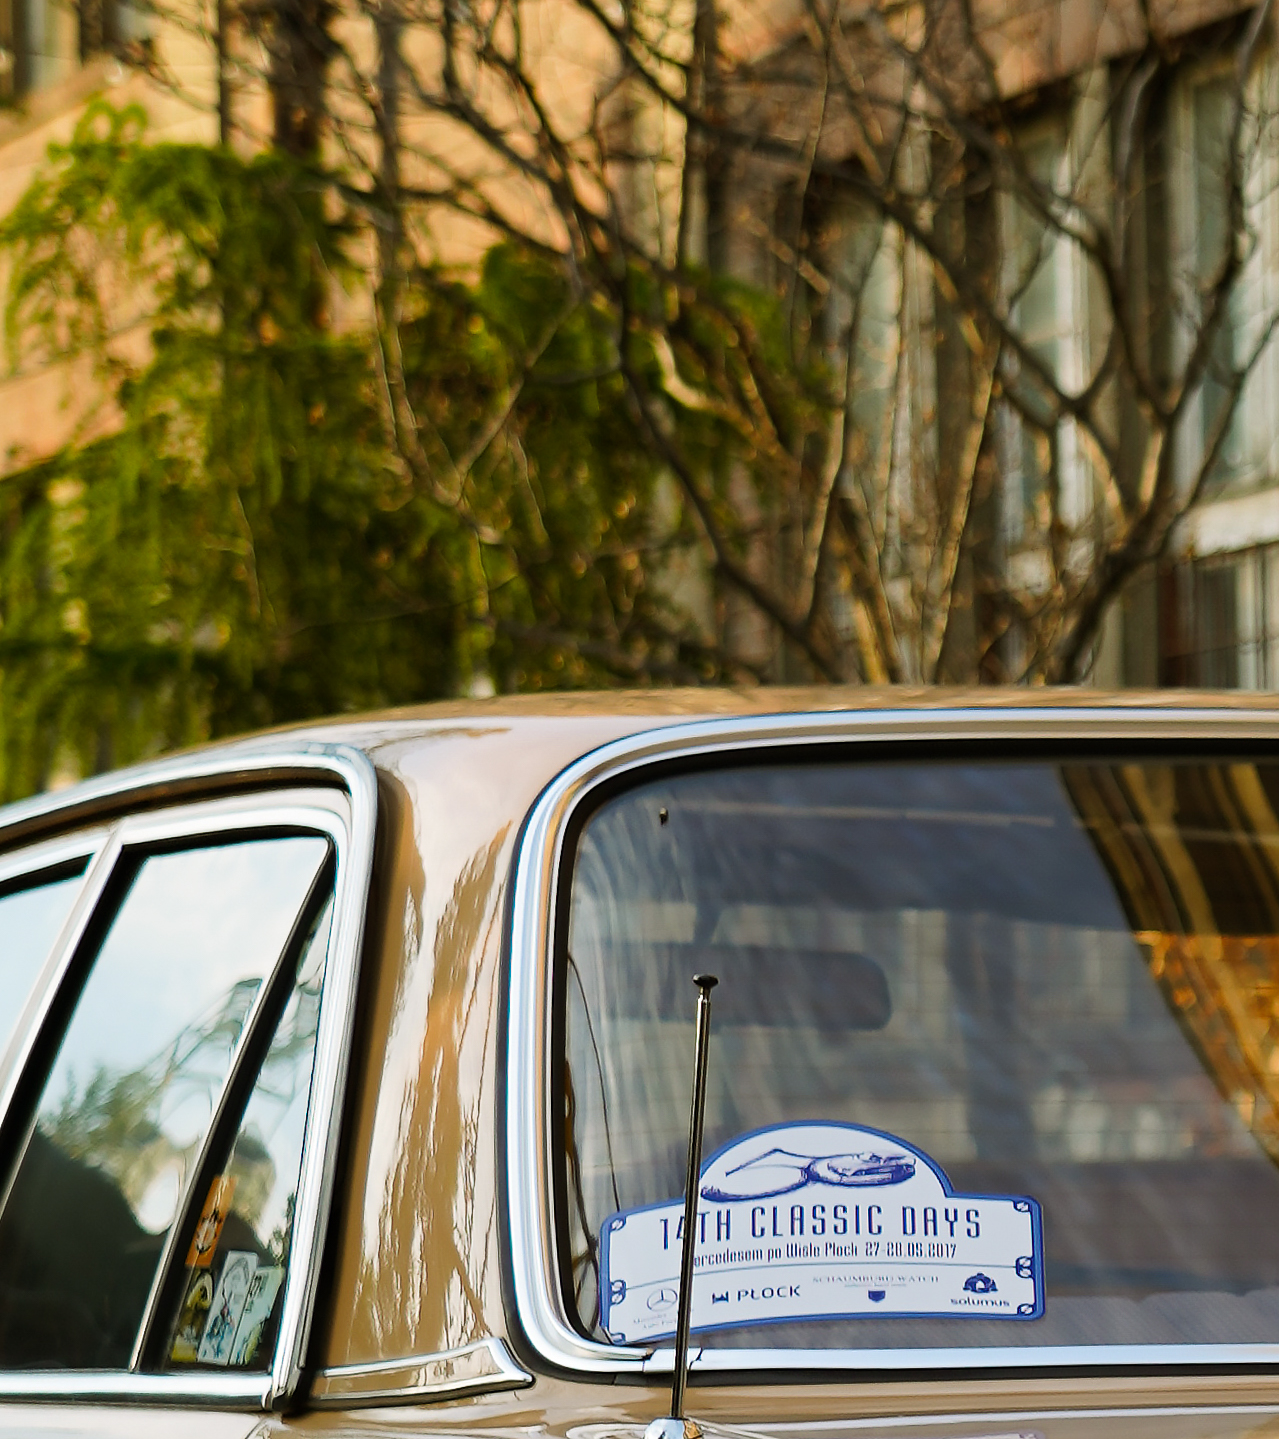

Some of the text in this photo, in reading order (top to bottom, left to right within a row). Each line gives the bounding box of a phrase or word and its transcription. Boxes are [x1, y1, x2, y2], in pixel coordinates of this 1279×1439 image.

[751, 1204, 883, 1239] CLASSIC
[902, 1206, 981, 1239] DAYS
[693, 1247, 763, 1268] ercedesem
[767, 1247, 782, 1263] po
[949, 1296, 1011, 1308] solumus
